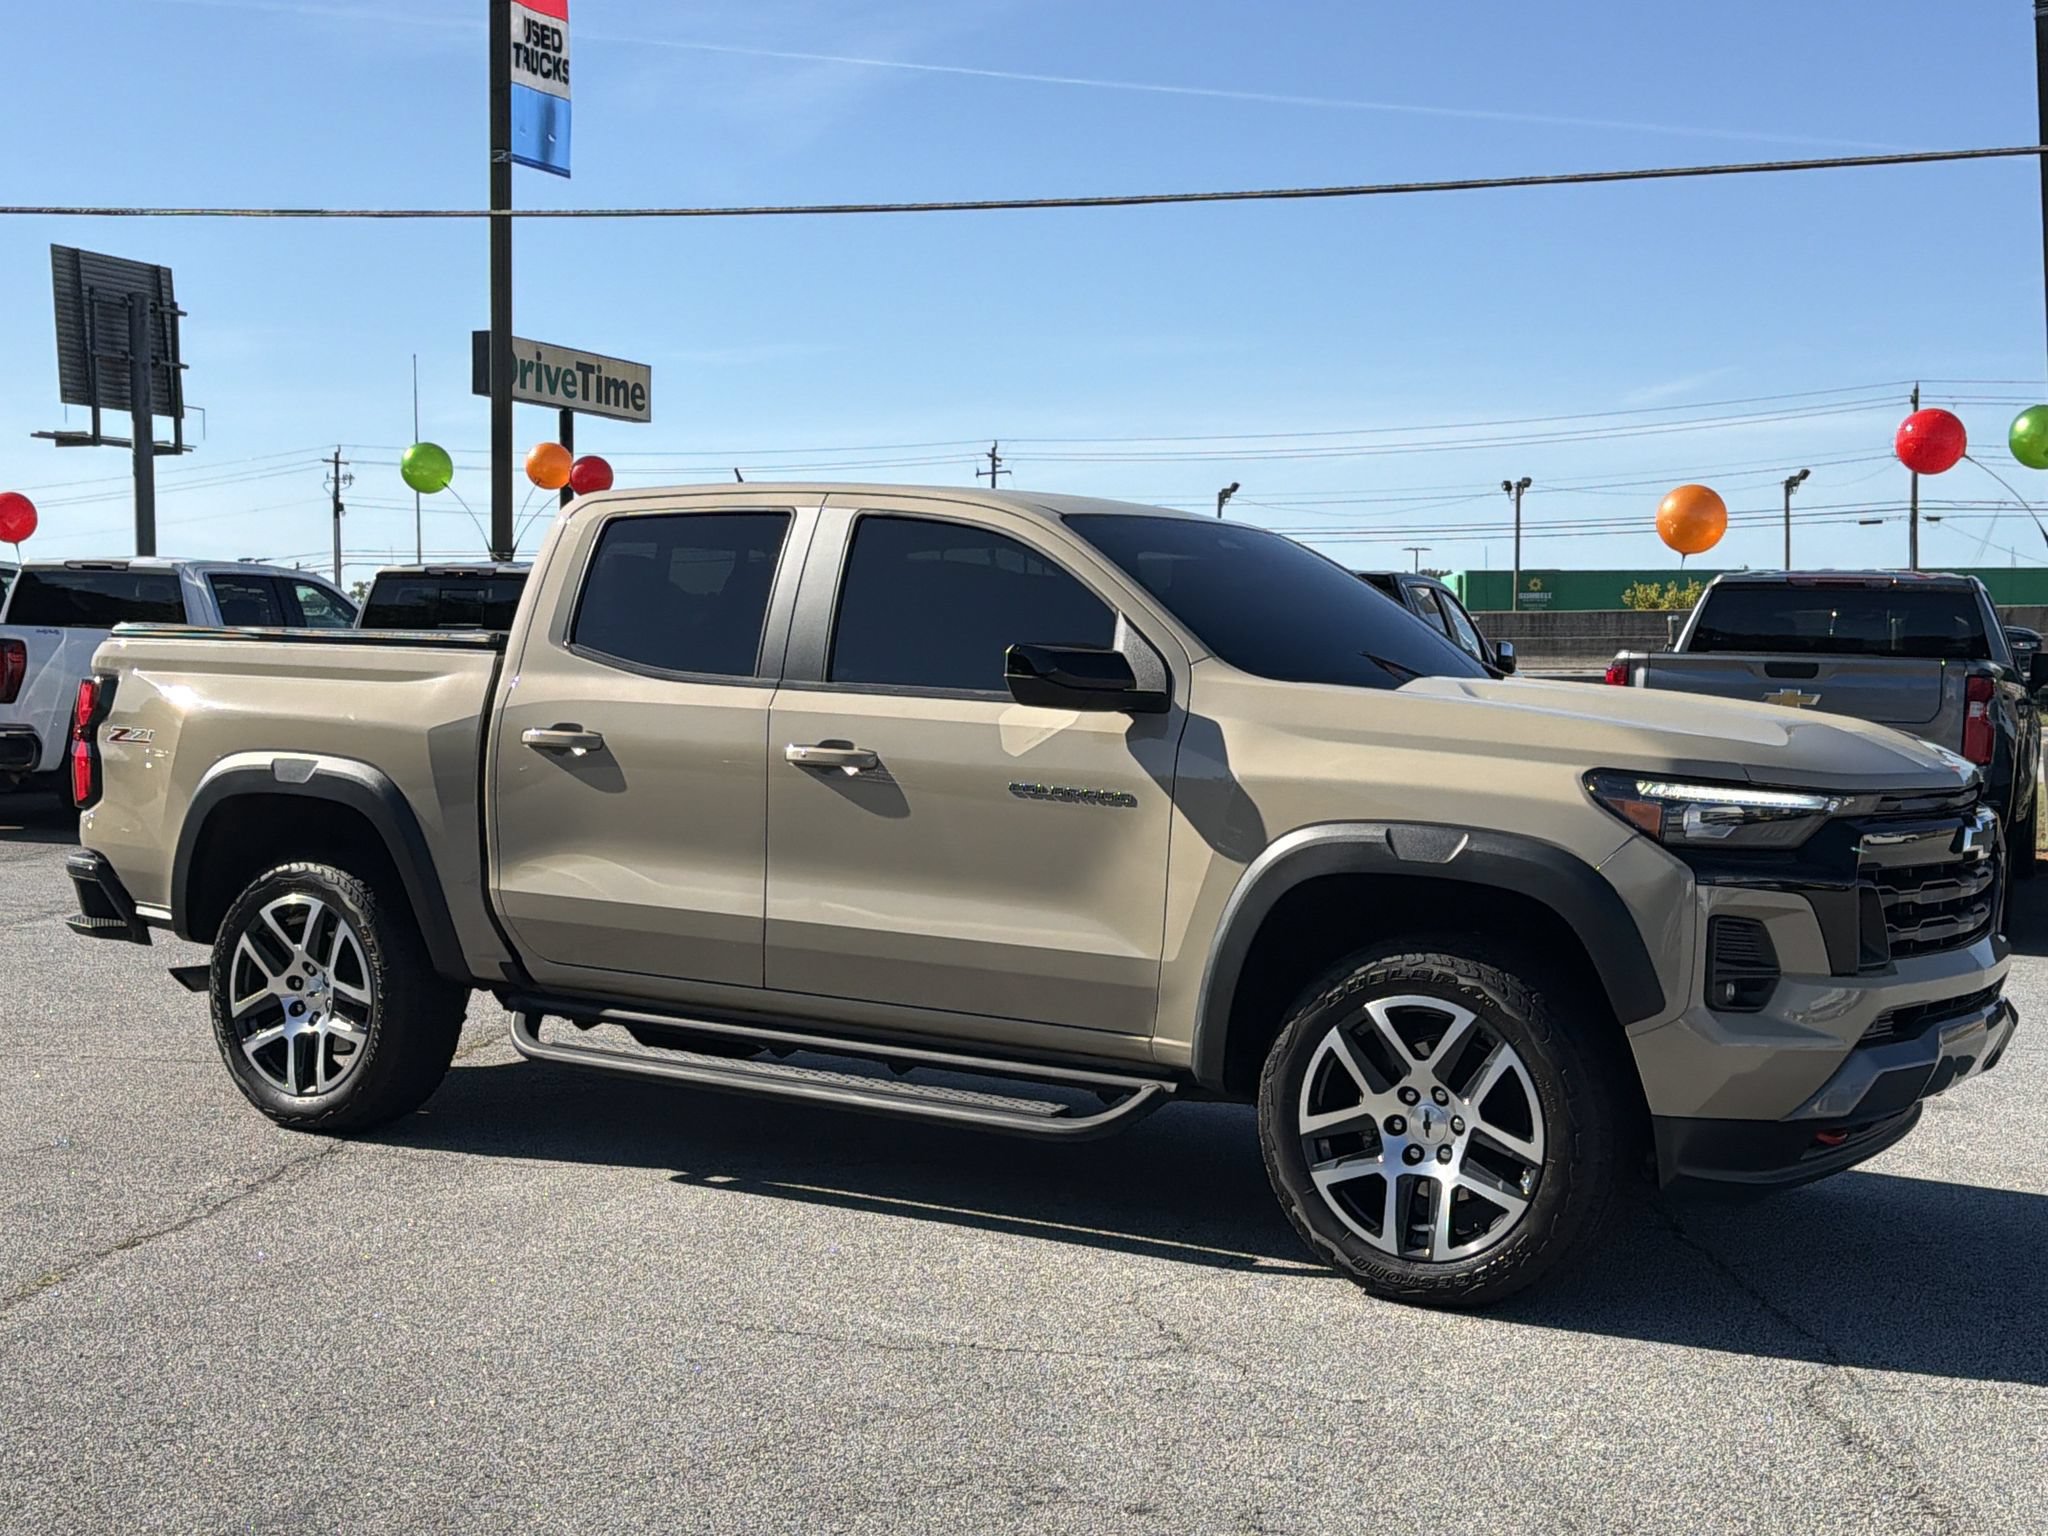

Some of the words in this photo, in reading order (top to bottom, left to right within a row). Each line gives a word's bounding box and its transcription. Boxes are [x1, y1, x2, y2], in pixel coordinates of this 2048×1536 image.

[524, 16, 562, 53] USED
[513, 42, 569, 84] TRUCKS
[512, 351, 646, 411] riveTime
[106, 726, 155, 744] Z71
[1008, 782, 1138, 808] COLORADO
